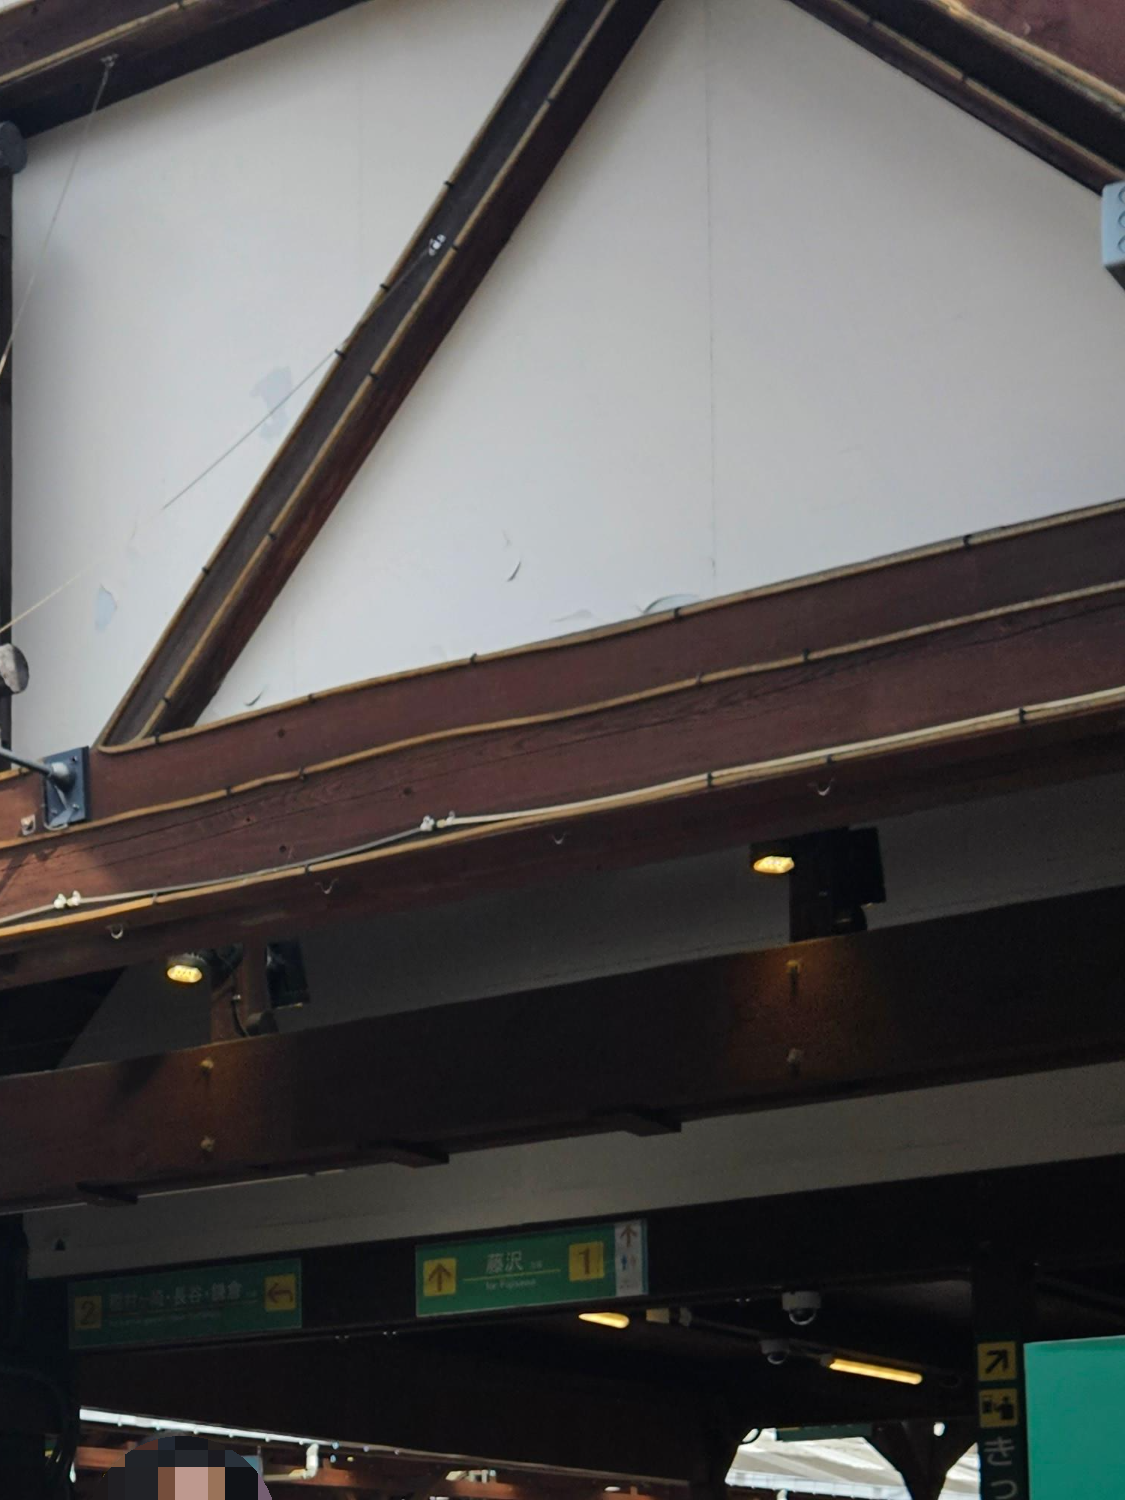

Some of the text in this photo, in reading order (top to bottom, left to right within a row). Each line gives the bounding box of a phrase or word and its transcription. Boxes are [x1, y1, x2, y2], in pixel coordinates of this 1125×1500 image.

[486, 1251, 524, 1274] 藤沢
[578, 1247, 591, 1276] 1
[81, 1300, 96, 1326] 2
